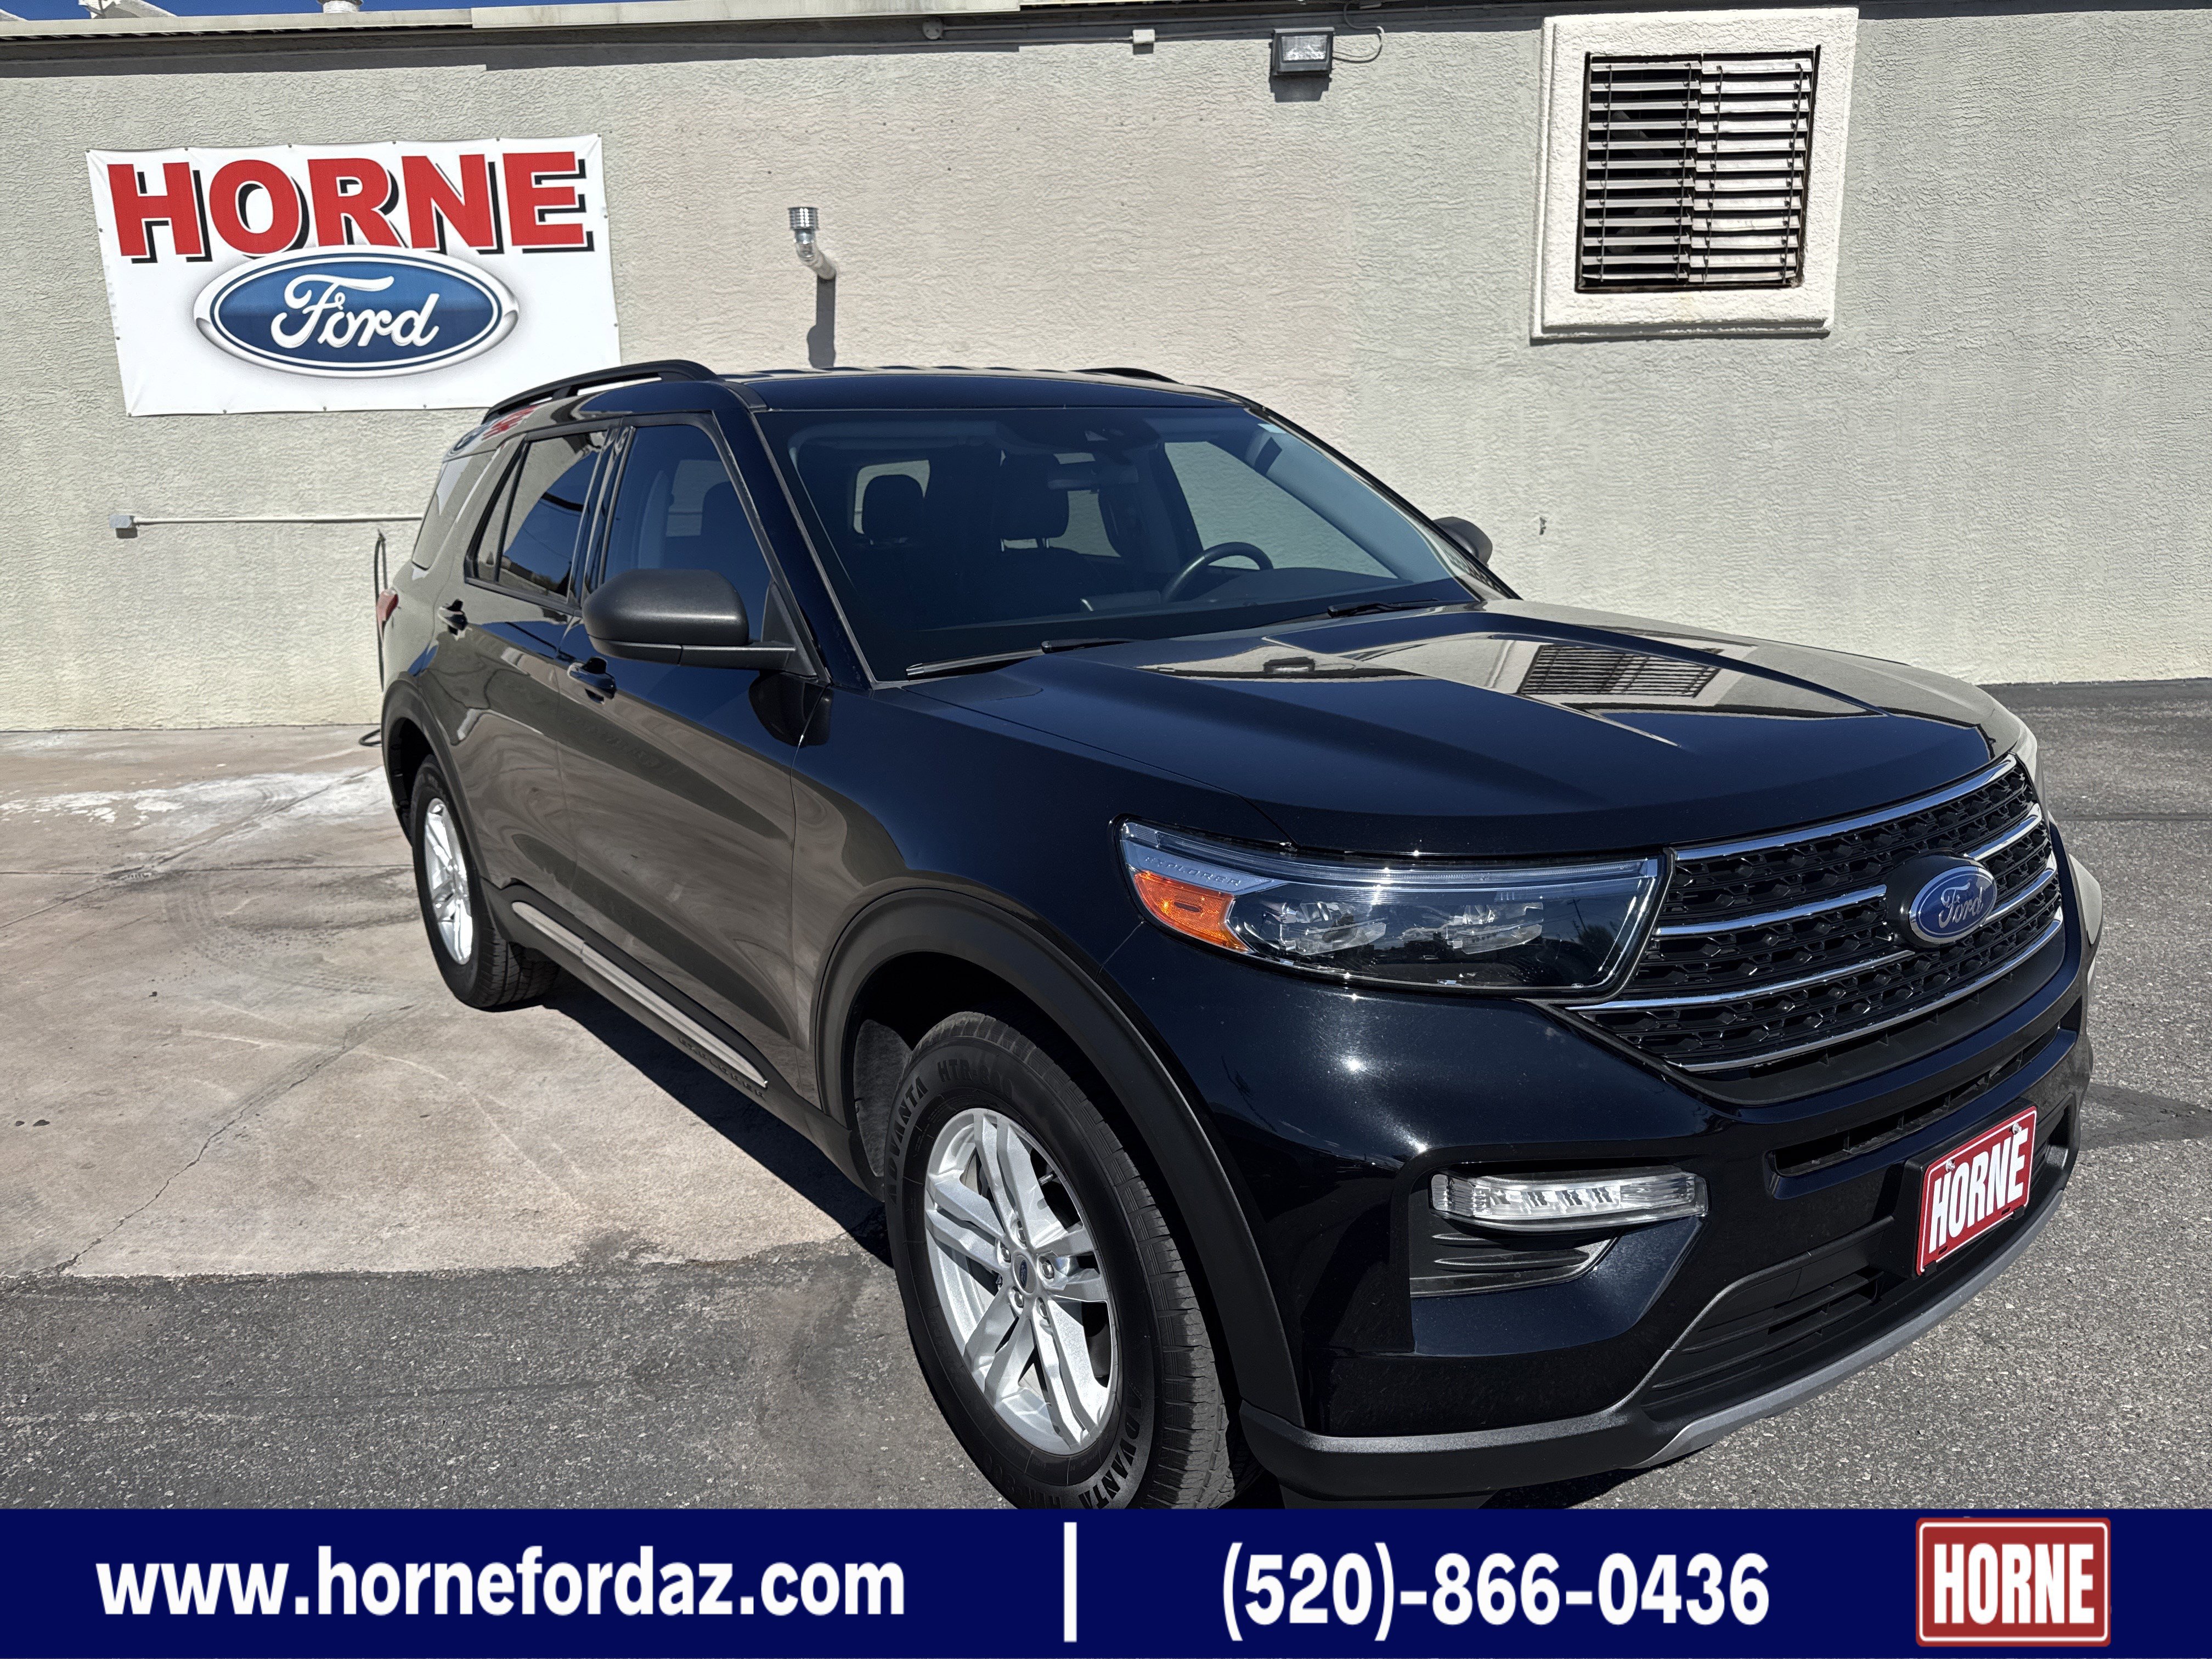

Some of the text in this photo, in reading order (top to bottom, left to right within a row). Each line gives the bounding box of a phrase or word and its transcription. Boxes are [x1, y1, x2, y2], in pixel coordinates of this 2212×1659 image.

[107, 151, 594, 263] HORNE
[271, 274, 439, 348] Ford
[1145, 856, 1242, 886] EXPLORER
[1938, 882, 1984, 928] Ford
[937, 1058, 1013, 1099] HTR-800
[888, 1075, 928, 1205] ADVANTA
[1929, 1126, 2028, 1254] HORNE
